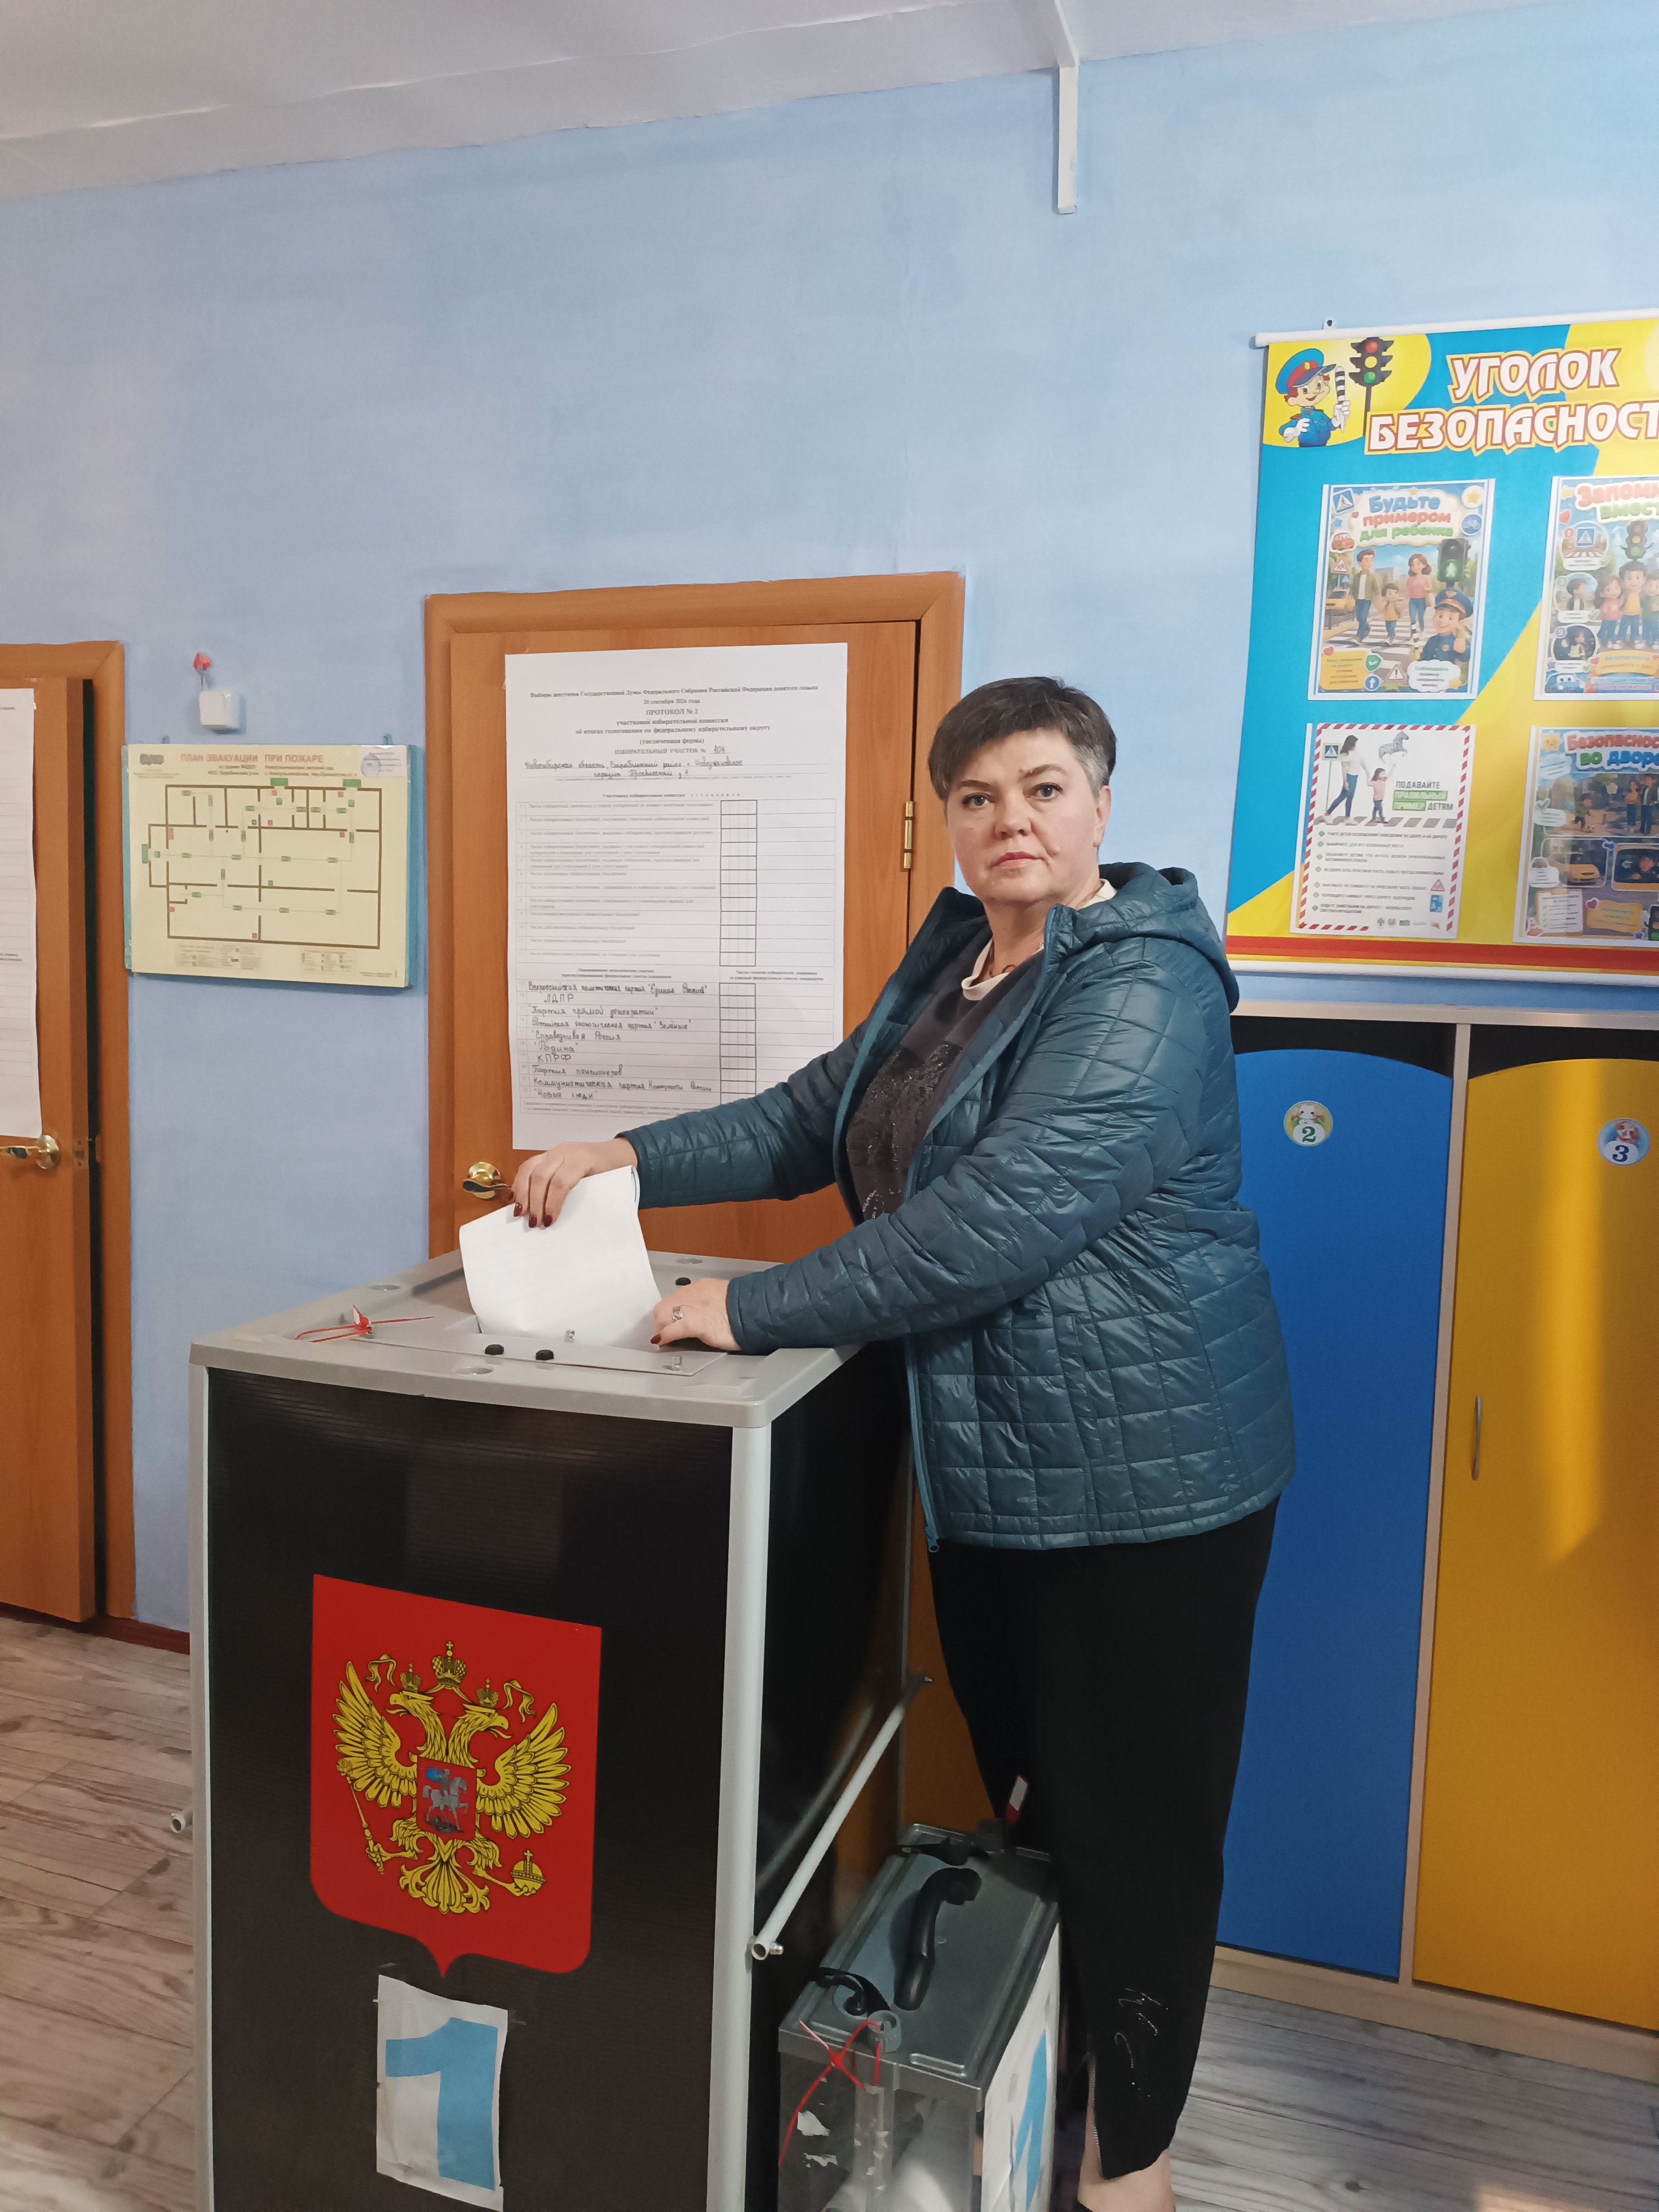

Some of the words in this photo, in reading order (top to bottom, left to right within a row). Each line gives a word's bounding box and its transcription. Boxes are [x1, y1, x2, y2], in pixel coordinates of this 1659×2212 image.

[1450, 347, 1622, 400] УГОЛОК
[1369, 495, 1441, 513] Будьте
[1363, 512, 1451, 528] примером
[1360, 528, 1387, 542] для
[206, 754, 258, 763] ЭВАКУАЦИИ
[285, 754, 324, 763] ПОЖАРЕ
[1580, 752, 1603, 766] во
[1396, 780, 1441, 789] ПОДАВАЙТЕ
[544, 993, 574, 1003] ЛДПР
[538, 1053, 572, 1062] КПРФ
[532, 1065, 566, 1076] Партия
[576, 1064, 623, 1078] пенсионеров
[1302, 1126, 1316, 1142] 2
[1612, 1145, 1629, 1162] 3
[385, 2017, 498, 2190] 1
